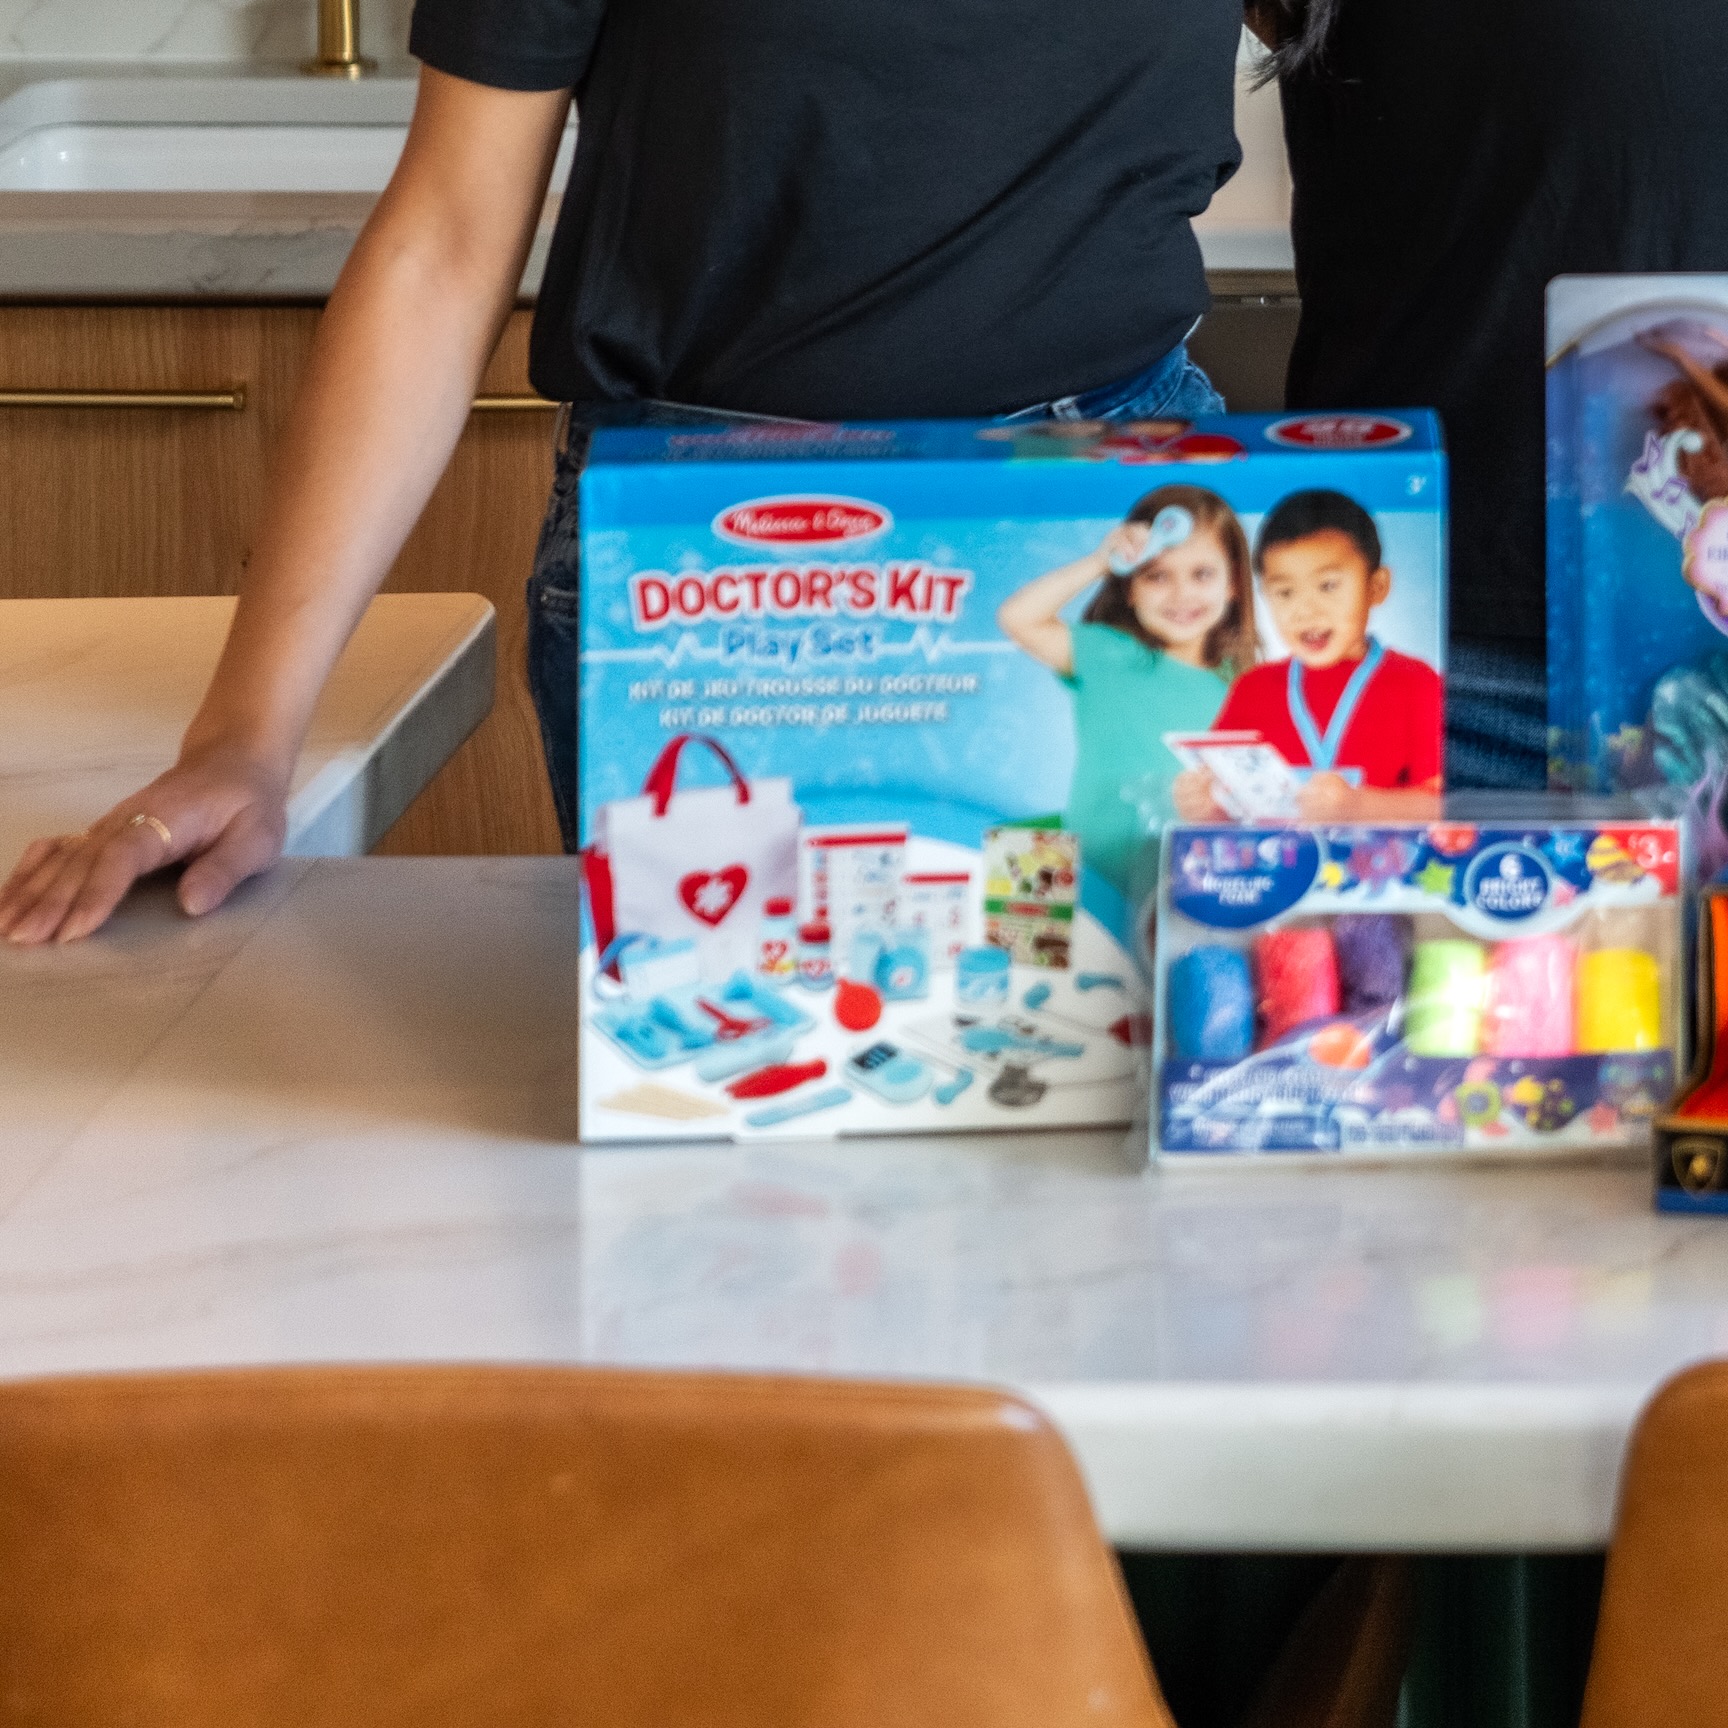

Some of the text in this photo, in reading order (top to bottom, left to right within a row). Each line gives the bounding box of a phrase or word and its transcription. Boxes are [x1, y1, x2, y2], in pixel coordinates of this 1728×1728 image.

[635, 566, 967, 624] DOCTOR'S KIT
[724, 625, 874, 665] Play Set
